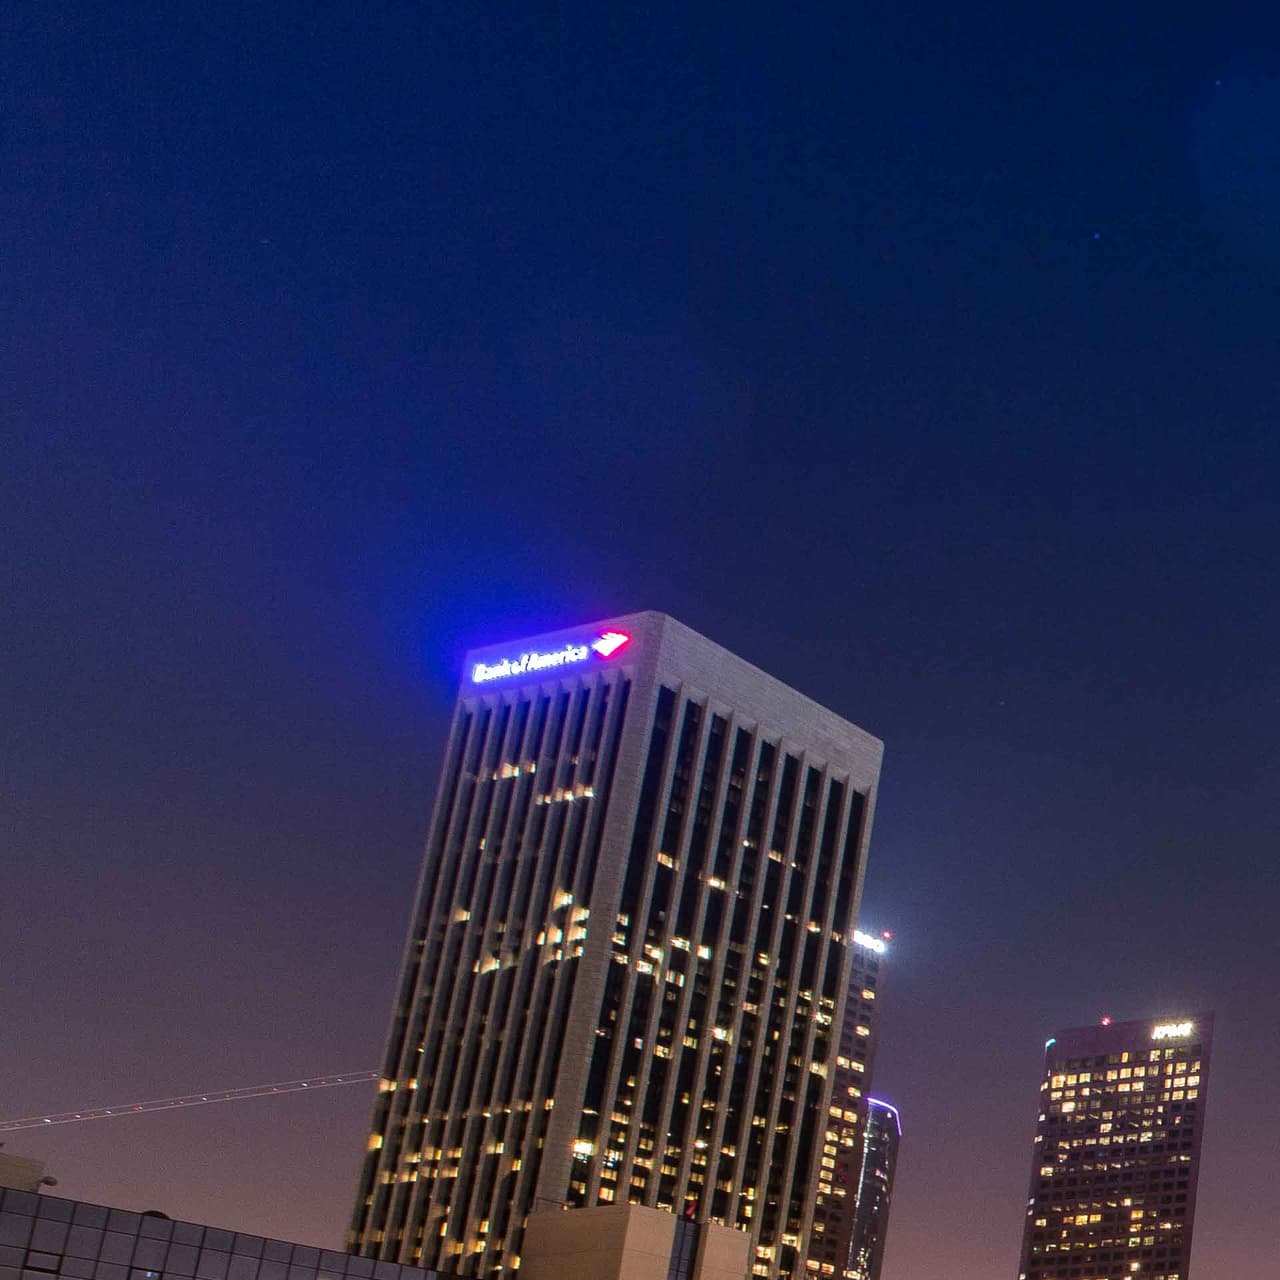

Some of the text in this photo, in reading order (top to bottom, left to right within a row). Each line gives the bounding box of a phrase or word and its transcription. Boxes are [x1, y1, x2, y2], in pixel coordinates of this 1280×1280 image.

[473, 644, 588, 682] Bank of America
